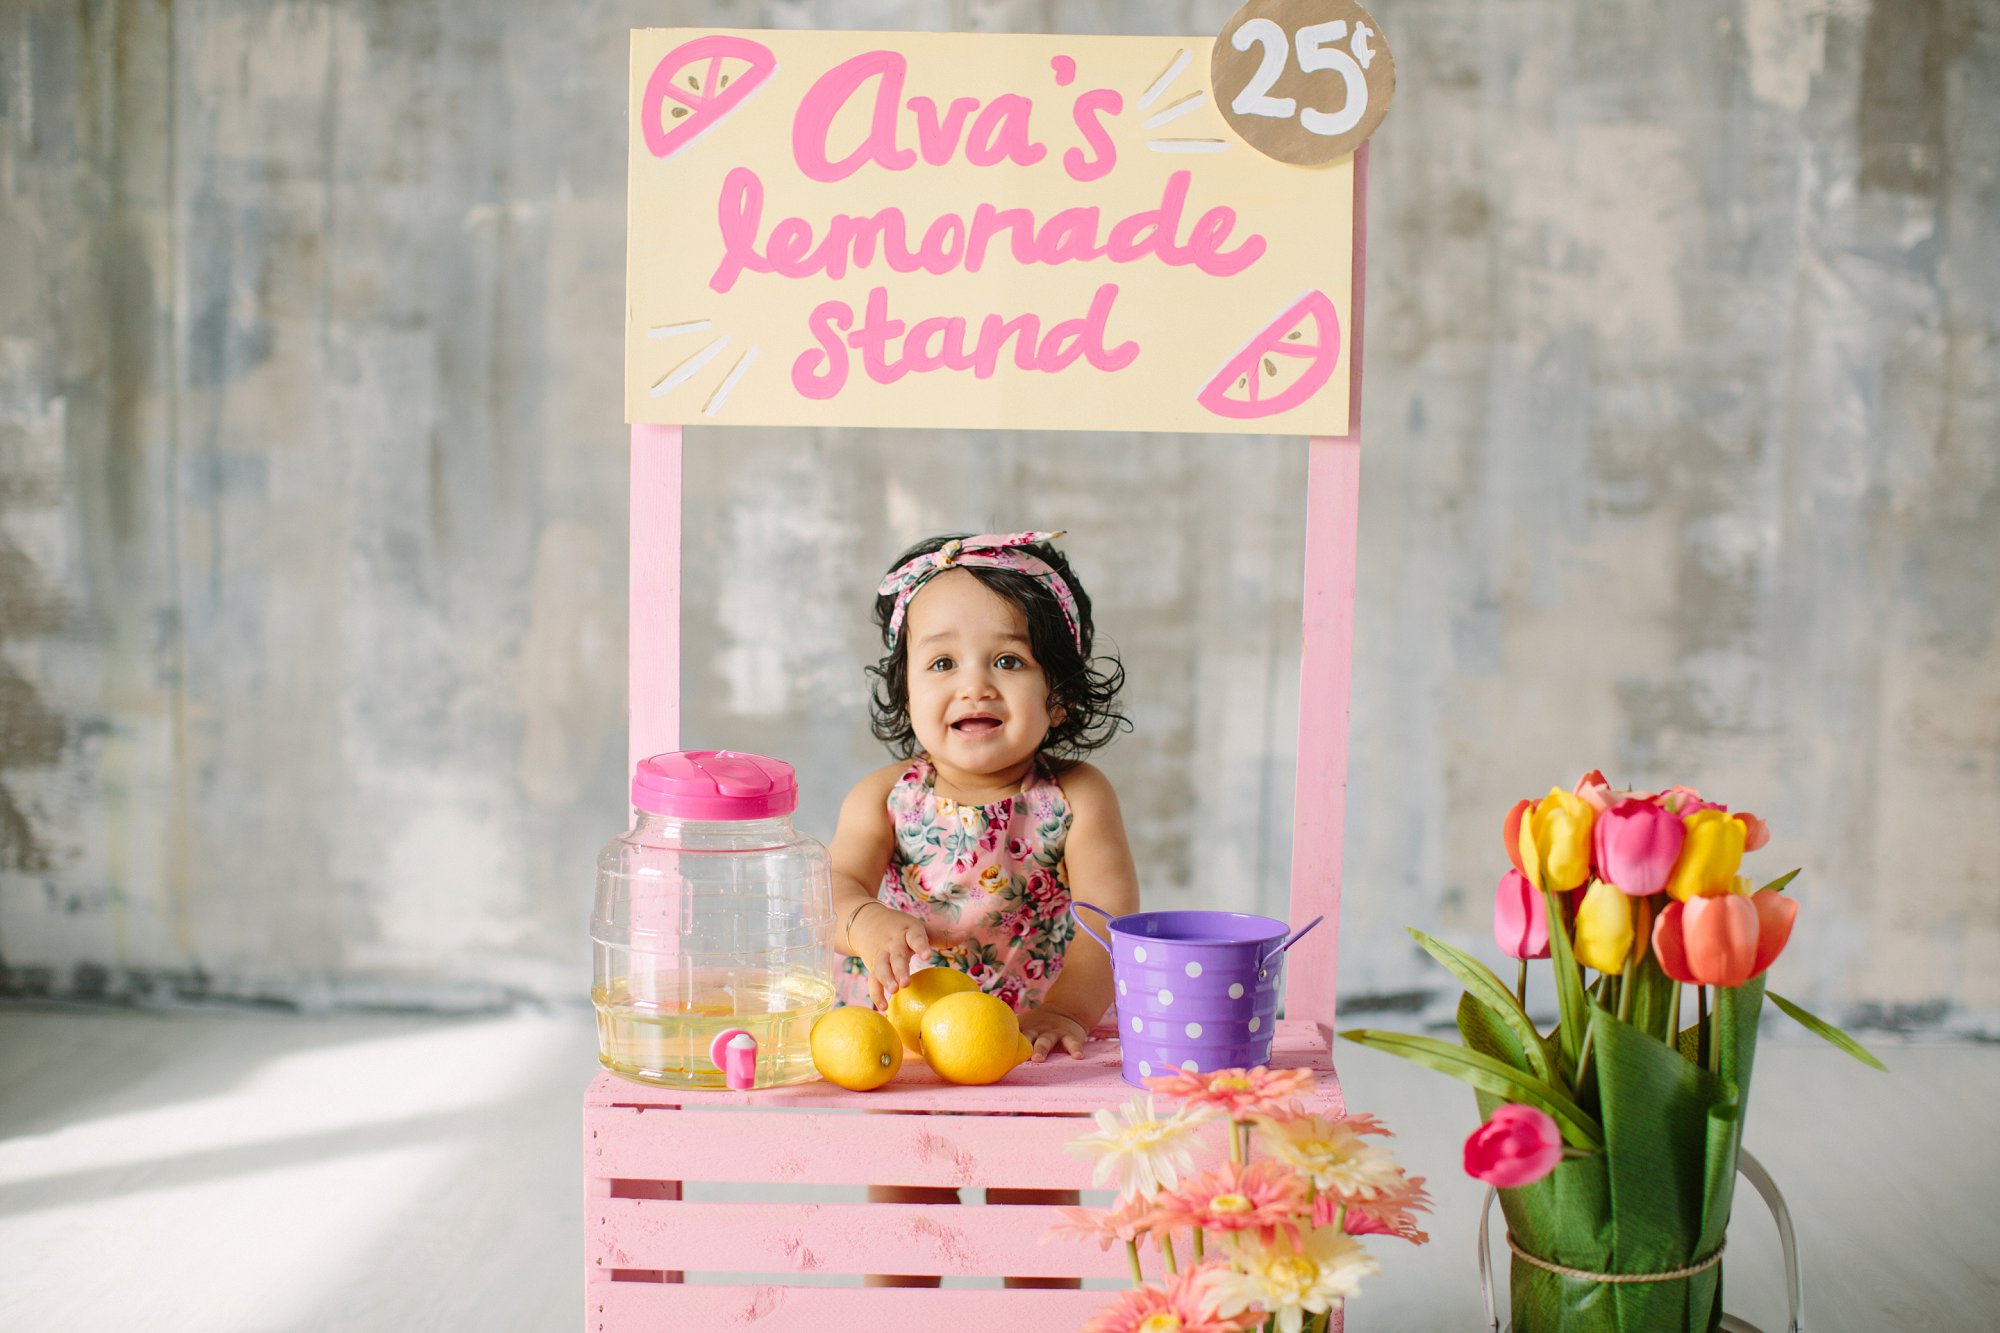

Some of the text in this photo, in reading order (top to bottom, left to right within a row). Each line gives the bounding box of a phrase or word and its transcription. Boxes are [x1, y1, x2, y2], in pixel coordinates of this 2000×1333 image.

[1231, 18, 1376, 136] 25¢
[709, 166, 1267, 293] lemonade
[791, 283, 1140, 400] stand
